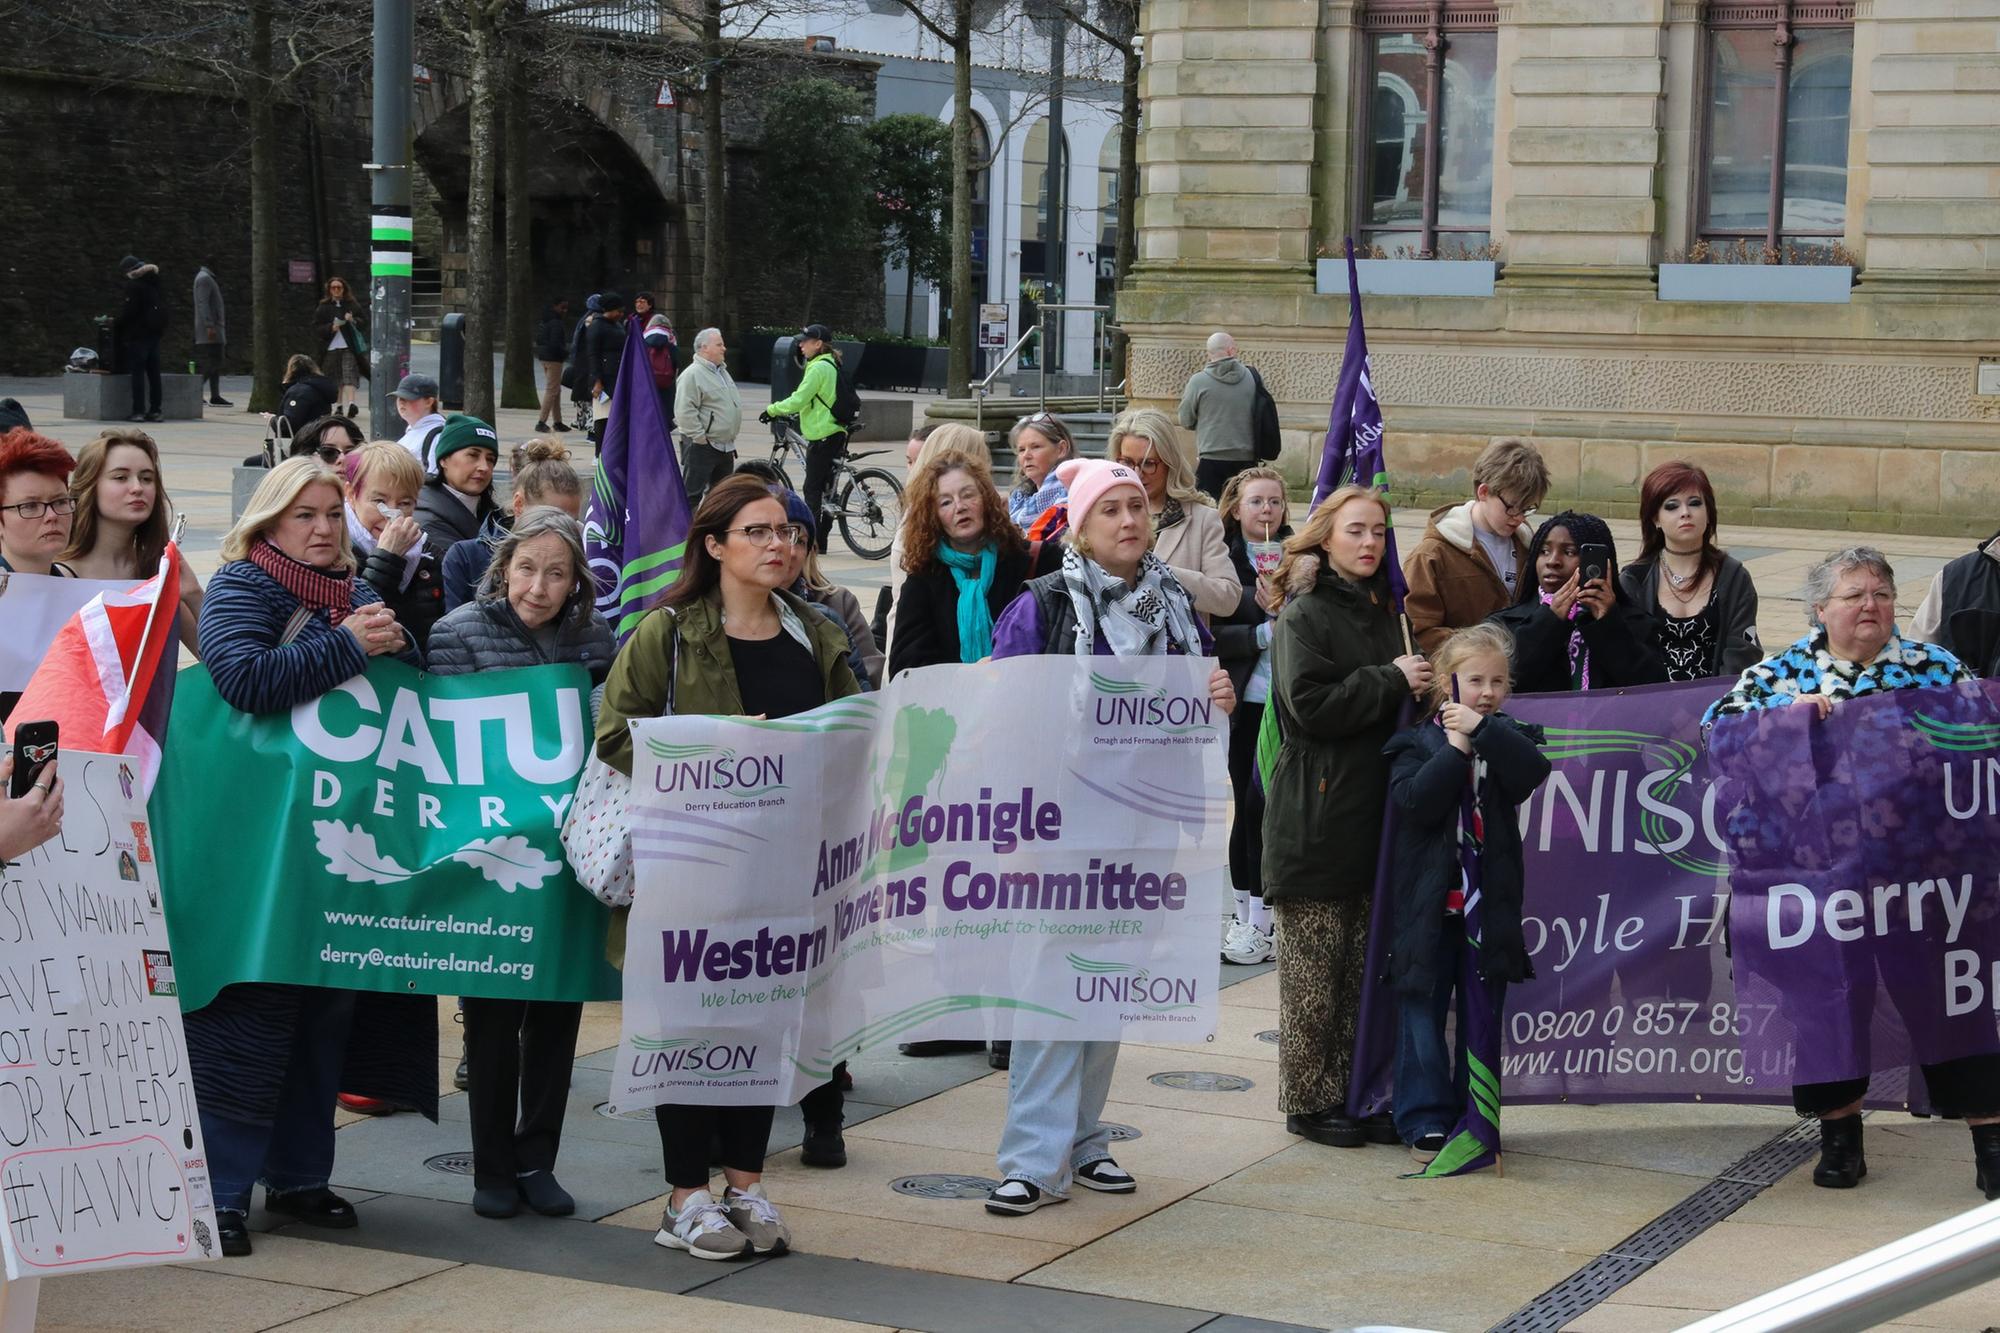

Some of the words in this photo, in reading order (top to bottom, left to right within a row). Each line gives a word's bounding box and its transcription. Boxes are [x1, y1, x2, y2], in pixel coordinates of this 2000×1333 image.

[291, 674, 584, 785] CATU
[1096, 697, 1211, 726] UNISON
[1094, 736, 1118, 746] Omagh
[1119, 736, 1133, 745] and
[1133, 736, 1172, 746] Fermanagh
[1173, 736, 1194, 745] Health
[655, 754, 784, 793] UNISON
[312, 770, 573, 829] DERRY
[685, 803, 711, 812] Derry
[712, 799, 756, 810] Education
[758, 797, 785, 808] Branch
[813, 831, 865, 897] Anna
[868, 787, 1062, 862] McGonigle
[38, 879, 148, 937] WANNA
[323, 909, 534, 943] www.catuireland.org
[662, 925, 828, 983] Western
[943, 858, 1187, 912] Committee
[1767, 874, 1973, 950] Derry
[77, 954, 143, 1017] FUN
[320, 942, 534, 981] derry@catuireland.org
[700, 991, 729, 1009] We
[730, 988, 768, 1007] love
[770, 983, 799, 1003] the
[953, 918, 1012, 941] fought
[1016, 920, 1034, 934] to
[1039, 919, 1104, 935] become
[1108, 919, 1143, 935] HER
[1076, 976, 1197, 1004] UNISON
[1120, 1013, 1141, 1023] Foyle
[1142, 1013, 1167, 1022] Health
[1169, 1014, 1197, 1023] Branch
[1511, 1010, 1595, 1044] 0800
[1602, 1005, 1625, 1036] 0
[1633, 1002, 1700, 1035] 857
[1709, 1002, 1777, 1036] 857
[44, 1028, 90, 1067] GET
[99, 1016, 179, 1078] RAPED
[631, 1045, 757, 1077] UNISON
[666, 1079, 705, 1087] Devenish
[707, 1079, 749, 1087] Education
[750, 1078, 779, 1087] Branch
[0, 1076, 48, 1146] OR
[4, 1152, 181, 1243] #VAWG
